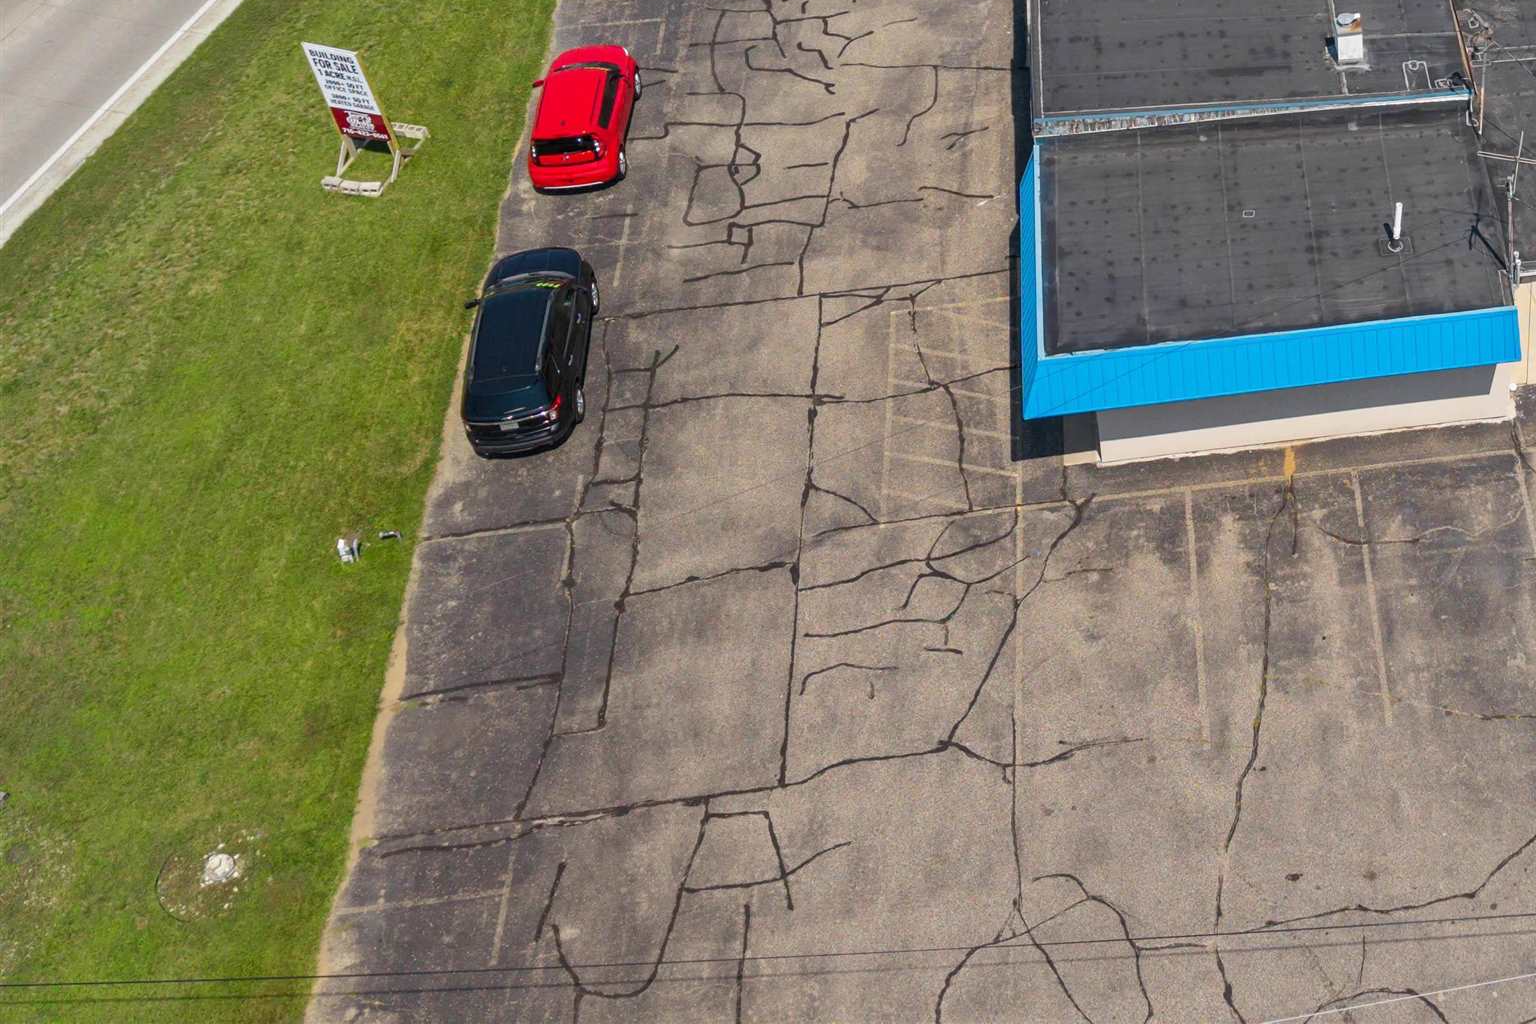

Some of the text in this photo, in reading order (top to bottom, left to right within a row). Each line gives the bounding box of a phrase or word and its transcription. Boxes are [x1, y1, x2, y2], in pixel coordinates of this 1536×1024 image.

[309, 49, 354, 64] BUILDING
[312, 57, 359, 75] FOR SALE
[324, 70, 346, 80] ACRE
